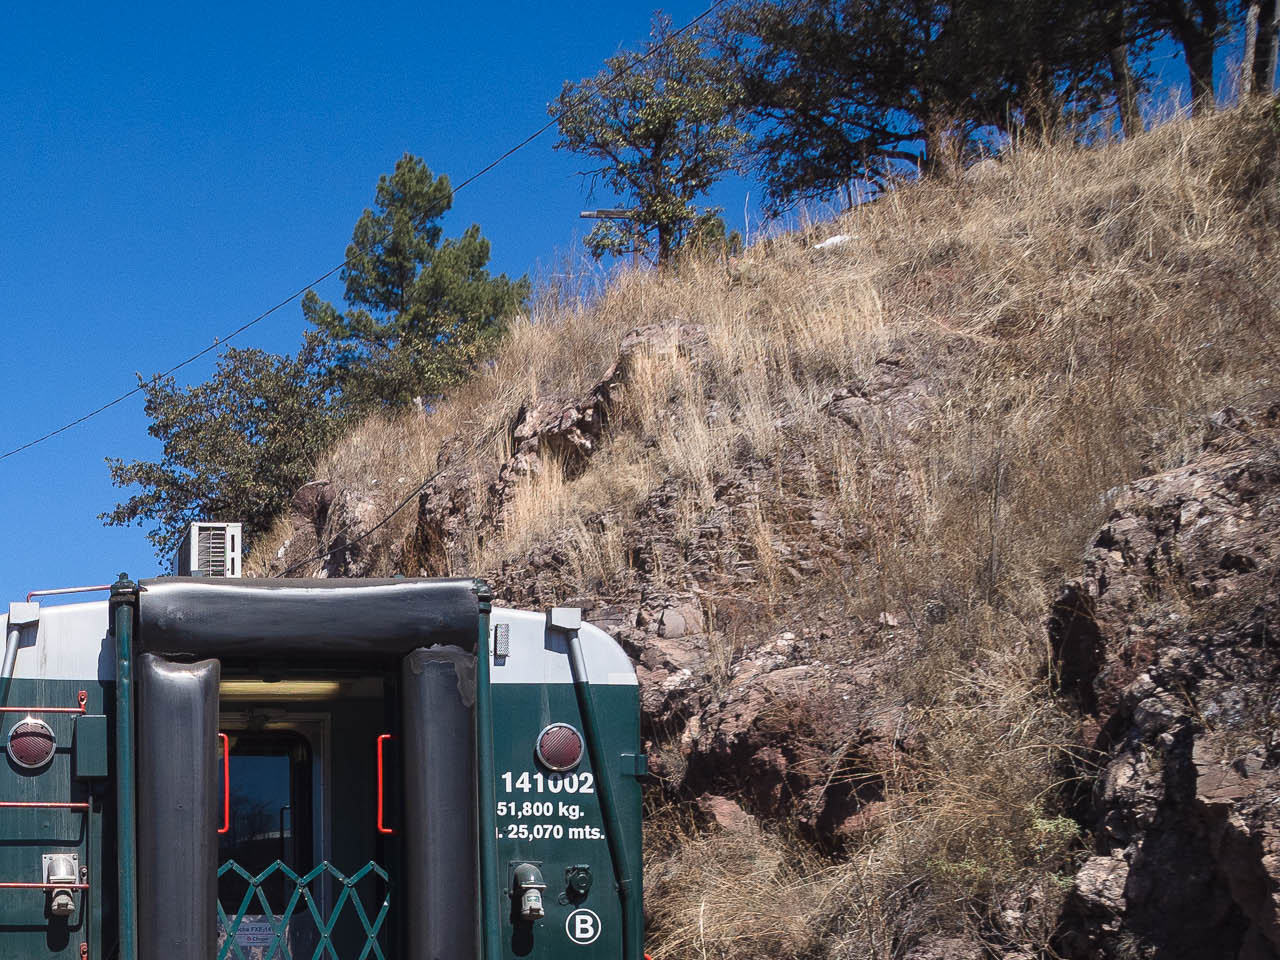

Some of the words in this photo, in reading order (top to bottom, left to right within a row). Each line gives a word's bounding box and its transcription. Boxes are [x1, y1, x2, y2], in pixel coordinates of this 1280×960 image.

[501, 772, 594, 793] 141002
[497, 802, 553, 818] 51,800
[558, 802, 585, 820] kg.
[508, 825, 563, 841] 25,070
[569, 826, 605, 840] mts.
[575, 915, 595, 938] B
